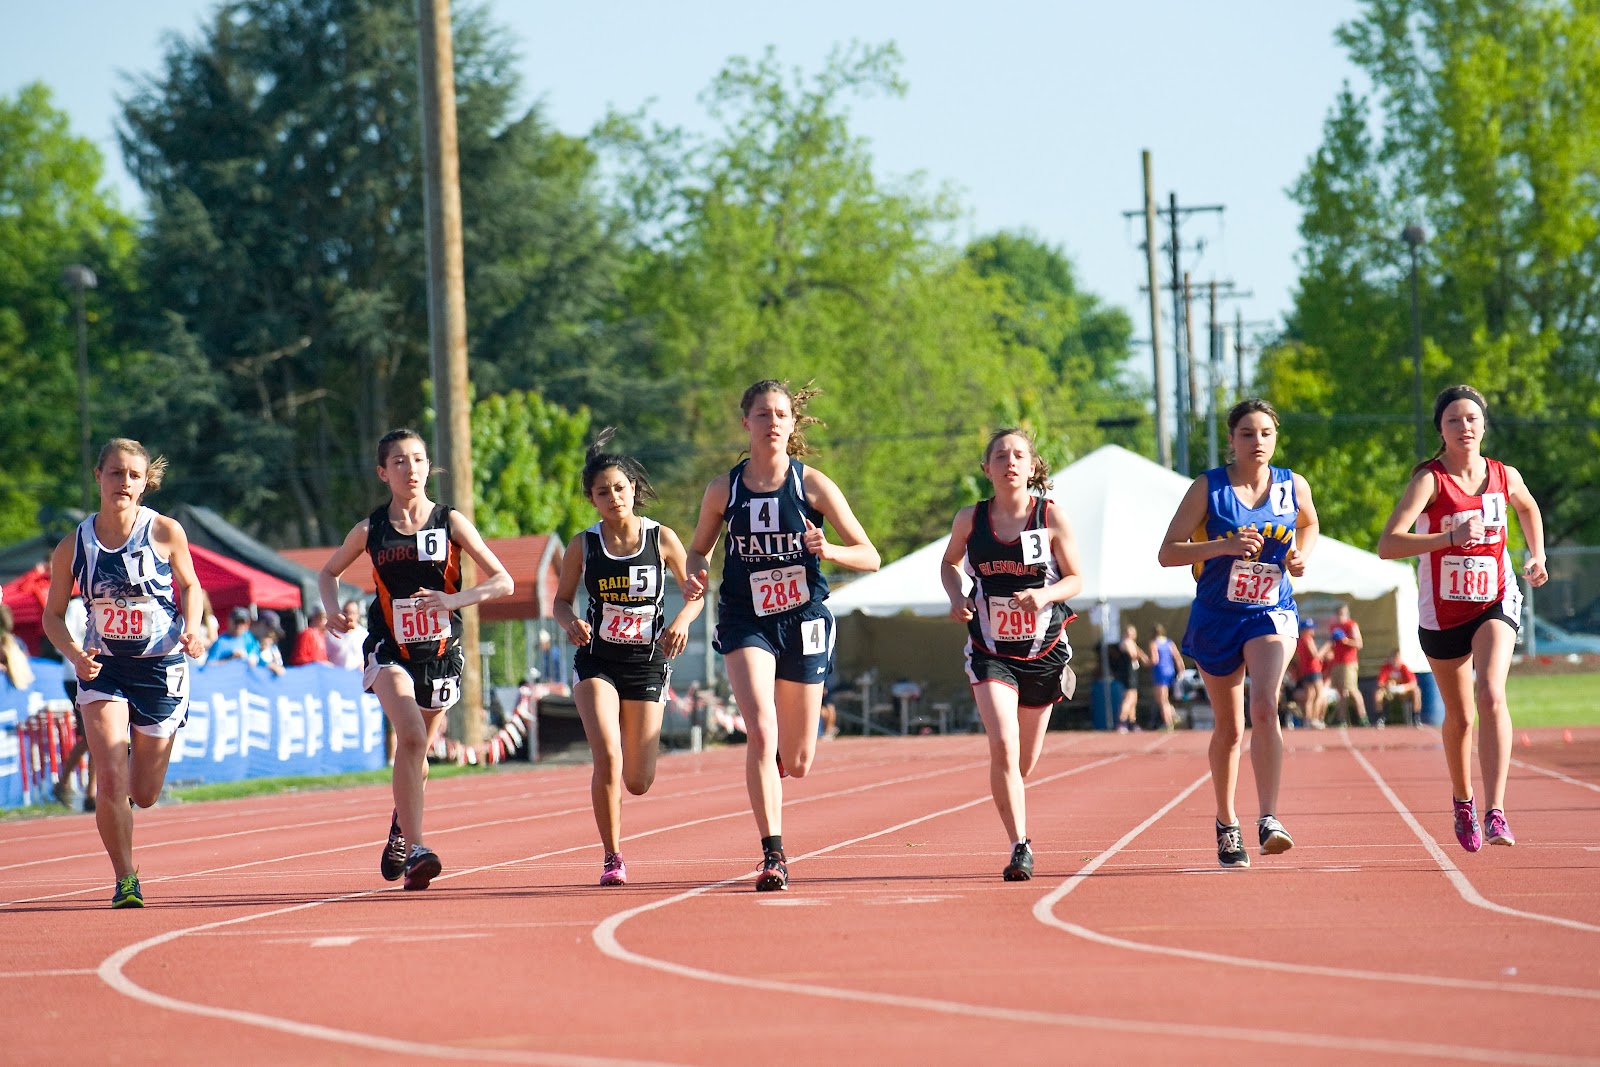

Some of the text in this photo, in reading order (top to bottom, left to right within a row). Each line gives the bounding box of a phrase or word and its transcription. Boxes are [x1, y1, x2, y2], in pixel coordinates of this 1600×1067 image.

[1280, 487, 1288, 509] 2
[1492, 497, 1500, 522] 1
[758, 502, 770, 528] 4
[425, 533, 437, 555] 6
[736, 532, 802, 554] FAITH
[1030, 534, 1042, 559] 3
[131, 551, 144, 577] 7
[378, 545, 418, 566] BOBC
[598, 576, 630, 591] RAID
[636, 569, 648, 592] 5
[1235, 574, 1274, 600] 532
[1450, 570, 1488, 595] 180
[760, 579, 801, 609] 284
[104, 608, 143, 634] 239
[402, 610, 442, 637] 501
[607, 616, 642, 639] 421
[997, 611, 1036, 635] 299
[810, 624, 819, 648] 4
[175, 667, 184, 692] 7
[440, 681, 450, 702] 6
